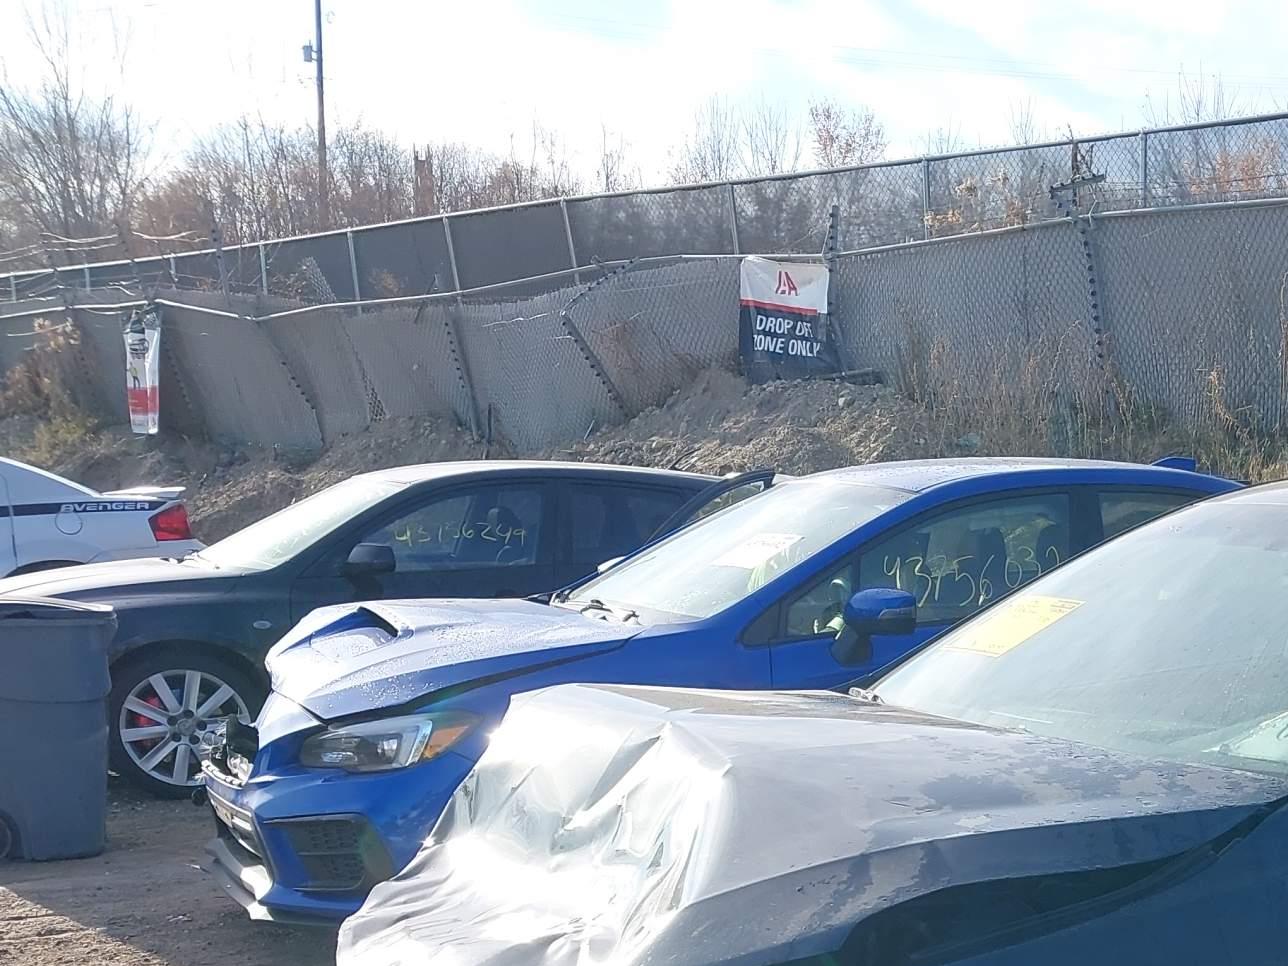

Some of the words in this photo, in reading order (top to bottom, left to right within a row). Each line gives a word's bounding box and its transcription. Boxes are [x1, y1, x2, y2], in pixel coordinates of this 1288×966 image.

[756, 315, 793, 334] DROP
[788, 339, 821, 357] ONLY
[60, 502, 150, 513] AVENGER
